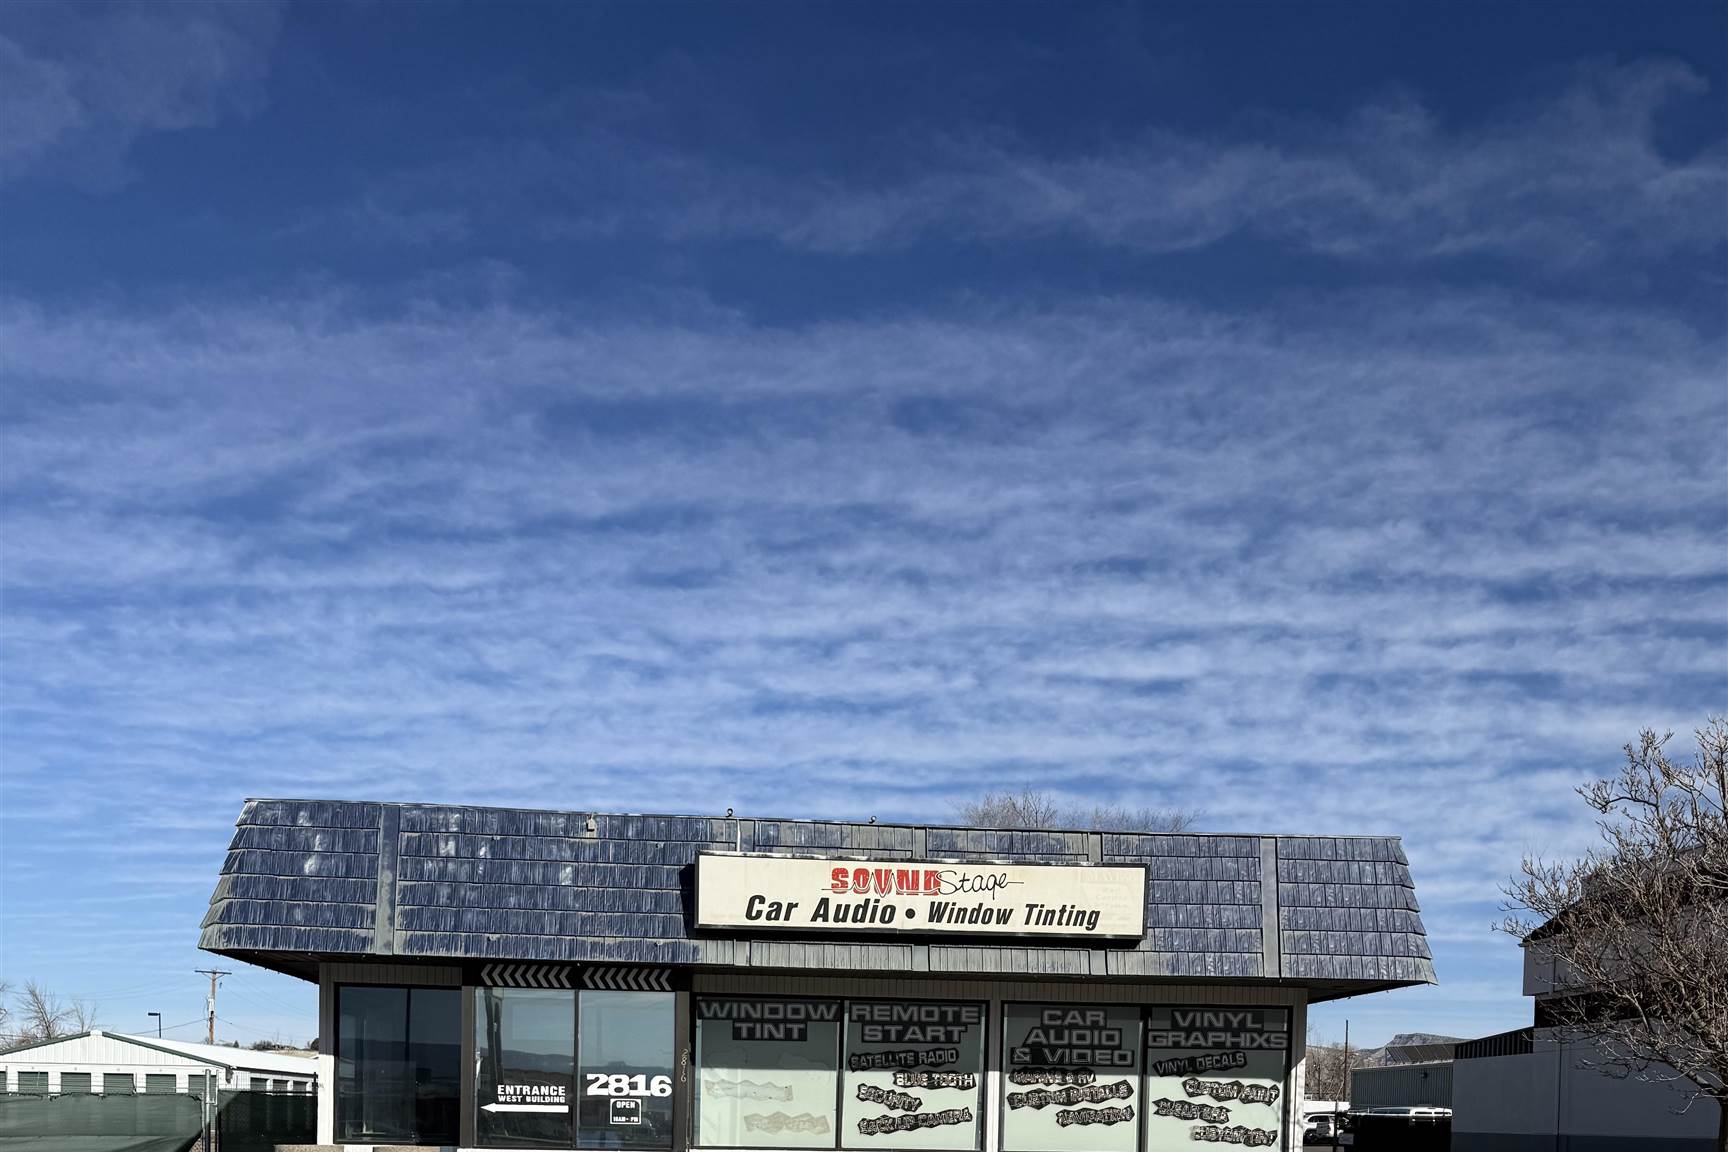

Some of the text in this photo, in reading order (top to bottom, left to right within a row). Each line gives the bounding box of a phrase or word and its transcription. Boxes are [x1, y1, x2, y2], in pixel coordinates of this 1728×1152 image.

[831, 867, 1012, 900] SOUND Stage
[745, 894, 1101, 931] Car Audio Window Tinting
[699, 1001, 839, 1020] WINDOW
[850, 1003, 980, 1022] REMOTE
[1042, 1009, 1106, 1026] CAR
[1172, 1010, 1263, 1029] VINYL
[734, 1022, 806, 1040] TINT
[862, 1024, 967, 1042] START
[1024, 1027, 1122, 1046] AUDIO
[1147, 1030, 1289, 1049] GRAPHIXS
[680, 1048, 689, 1083] 2816
[850, 1049, 957, 1069] SATELLITE RADIO
[1013, 1046, 1133, 1066] & VIDEO
[1156, 1052, 1245, 1075] VINYL DECALS
[586, 1073, 673, 1098] 2816
[931, 1072, 974, 1088] TOOTH
[497, 1084, 566, 1096] ENTRANCE
[525, 1095, 566, 1103] BUILDING
[616, 1100, 636, 1109] OPEN
